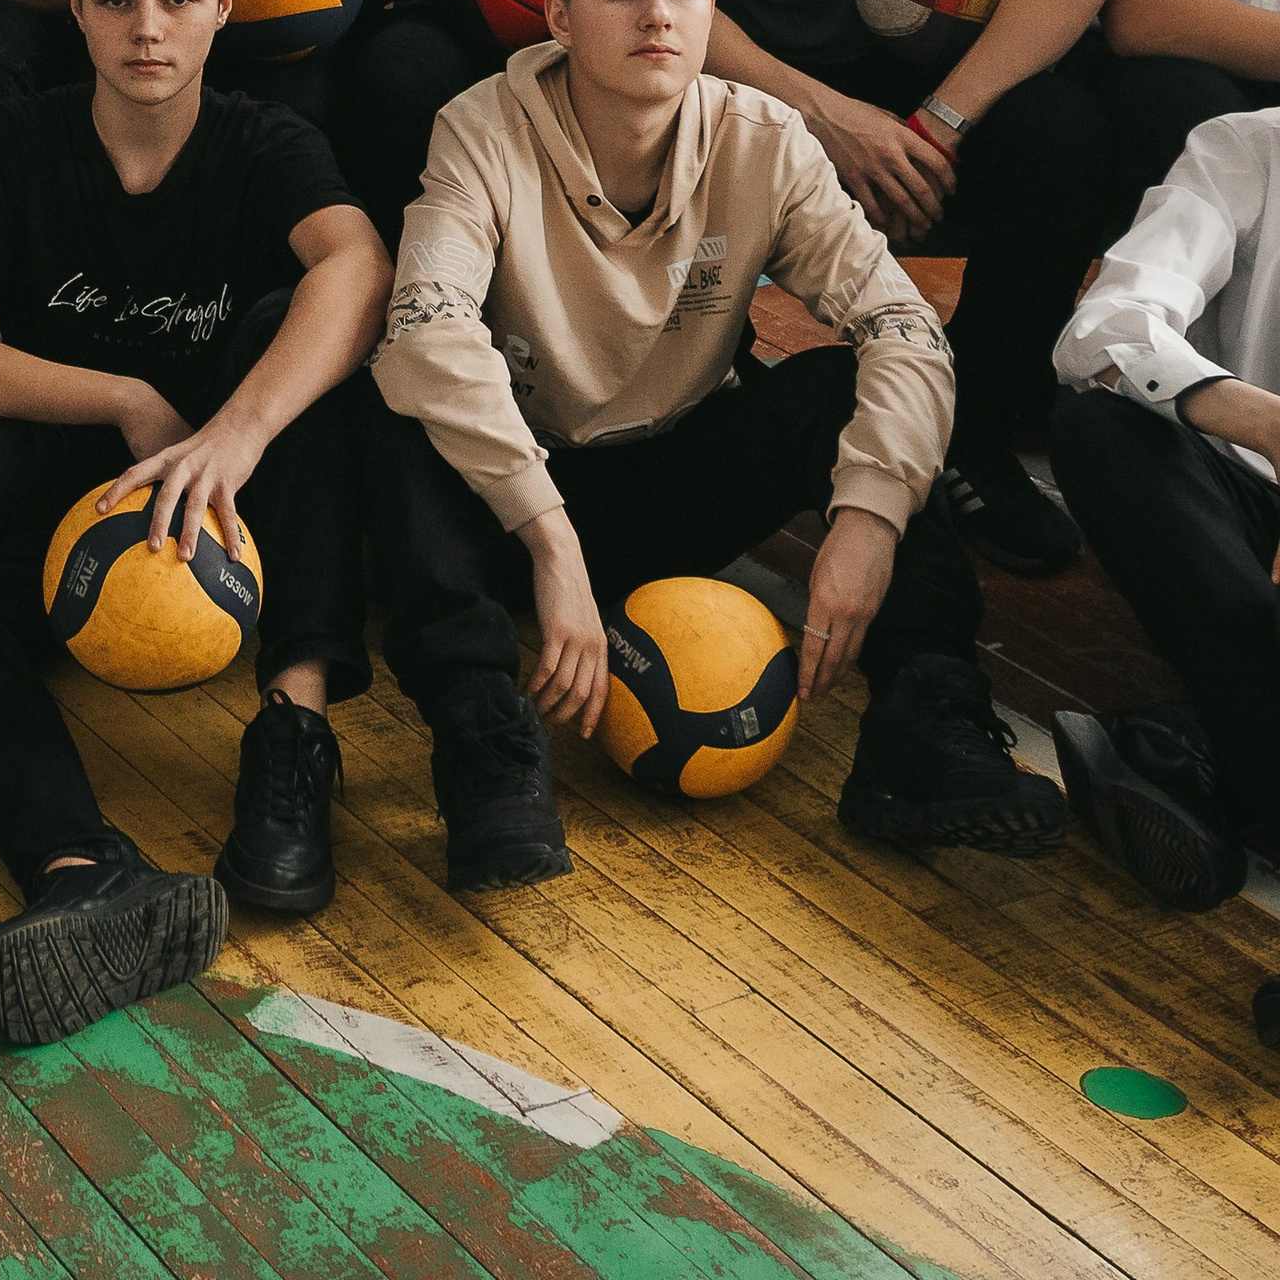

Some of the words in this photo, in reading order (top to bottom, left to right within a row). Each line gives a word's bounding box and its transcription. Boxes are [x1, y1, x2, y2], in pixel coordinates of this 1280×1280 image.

[48, 272, 109, 313] Life
[74, 556, 100, 599] FIVB
[219, 567, 254, 606] V330W
